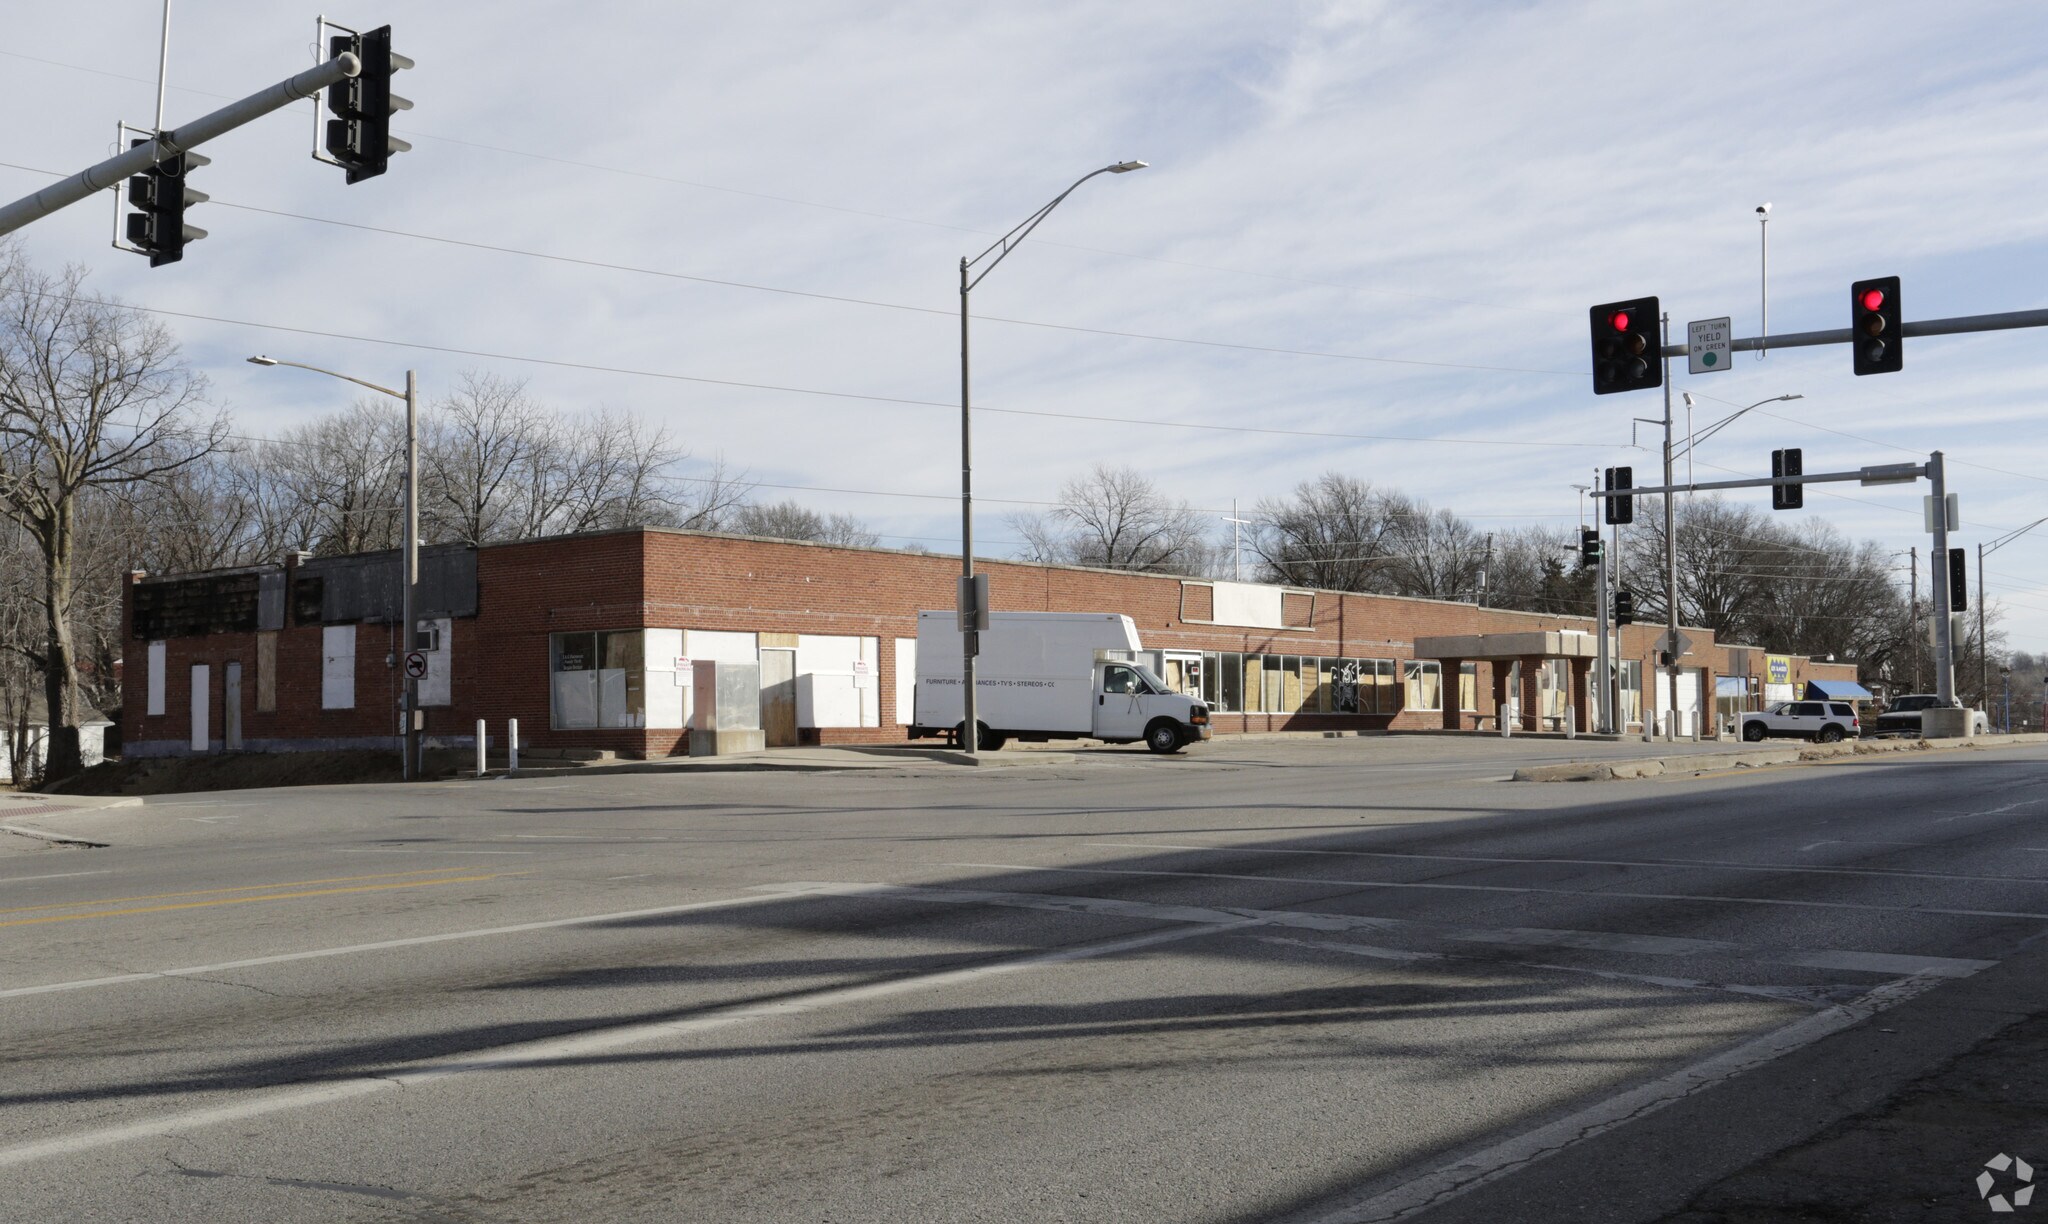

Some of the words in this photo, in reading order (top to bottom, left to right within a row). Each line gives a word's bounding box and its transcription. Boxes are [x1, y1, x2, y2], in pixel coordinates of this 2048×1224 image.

[1691, 325, 1706, 333] LEFT
[1711, 322, 1727, 331] TURN
[1698, 332, 1721, 342] YIELD
[1706, 342, 1726, 351] GREEN
